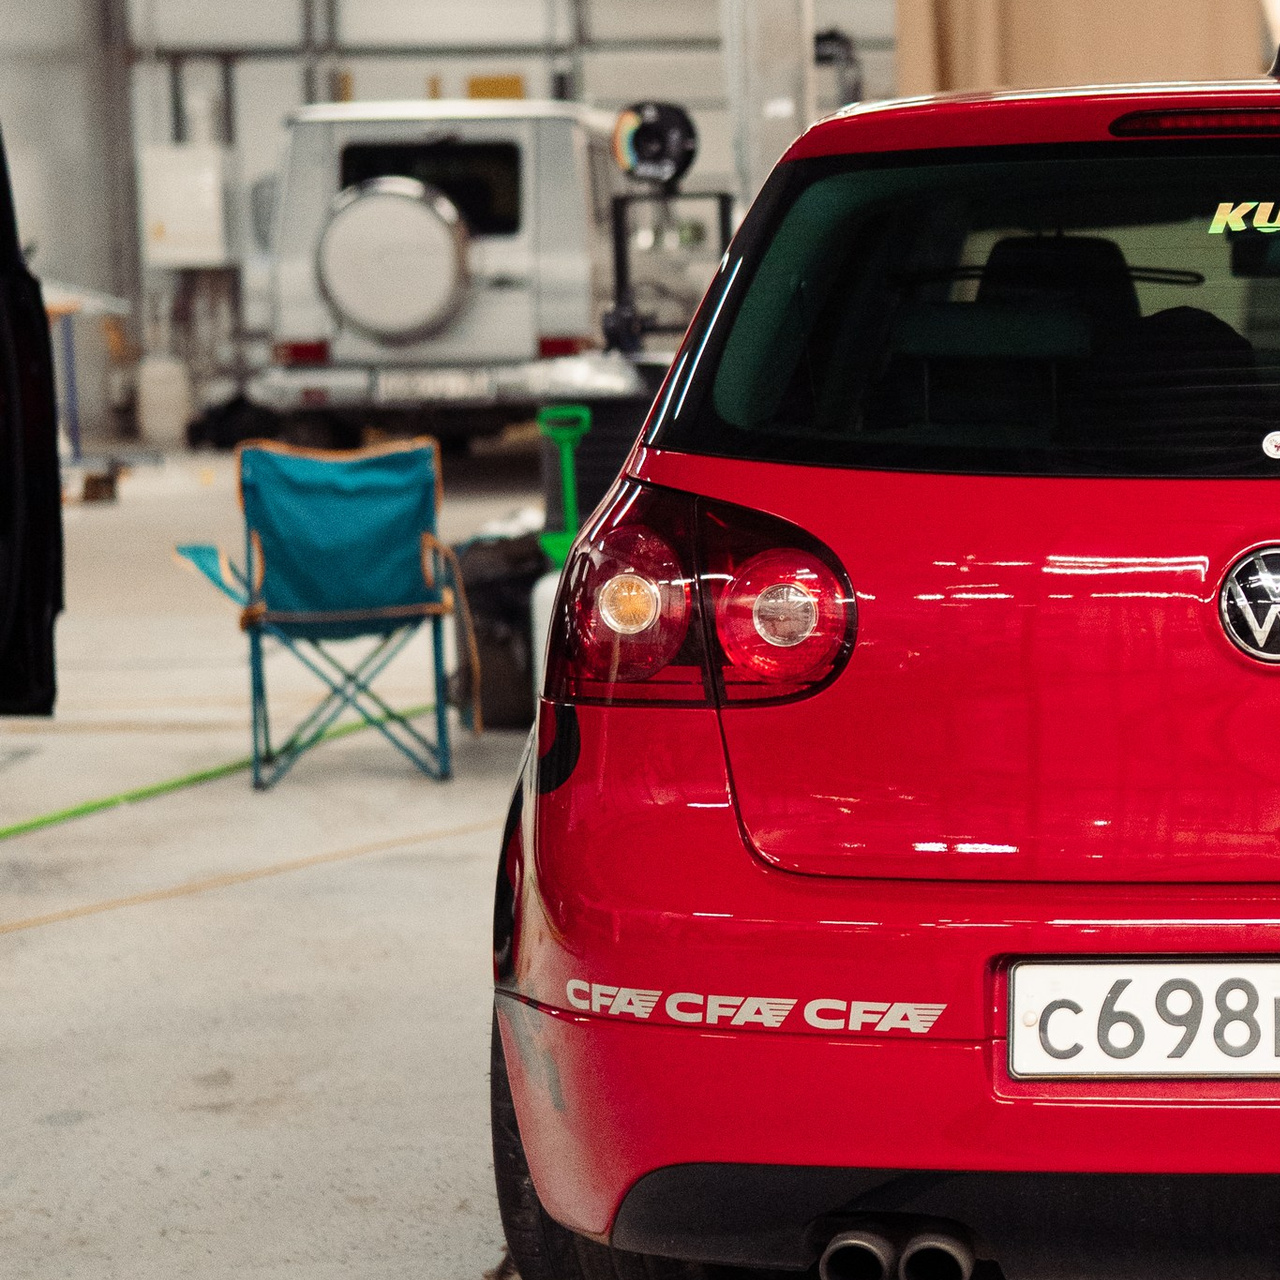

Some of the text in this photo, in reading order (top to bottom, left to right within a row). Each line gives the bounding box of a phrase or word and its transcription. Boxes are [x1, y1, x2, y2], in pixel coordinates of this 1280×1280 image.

[566, 978, 948, 1034] CFA CFA CFA
